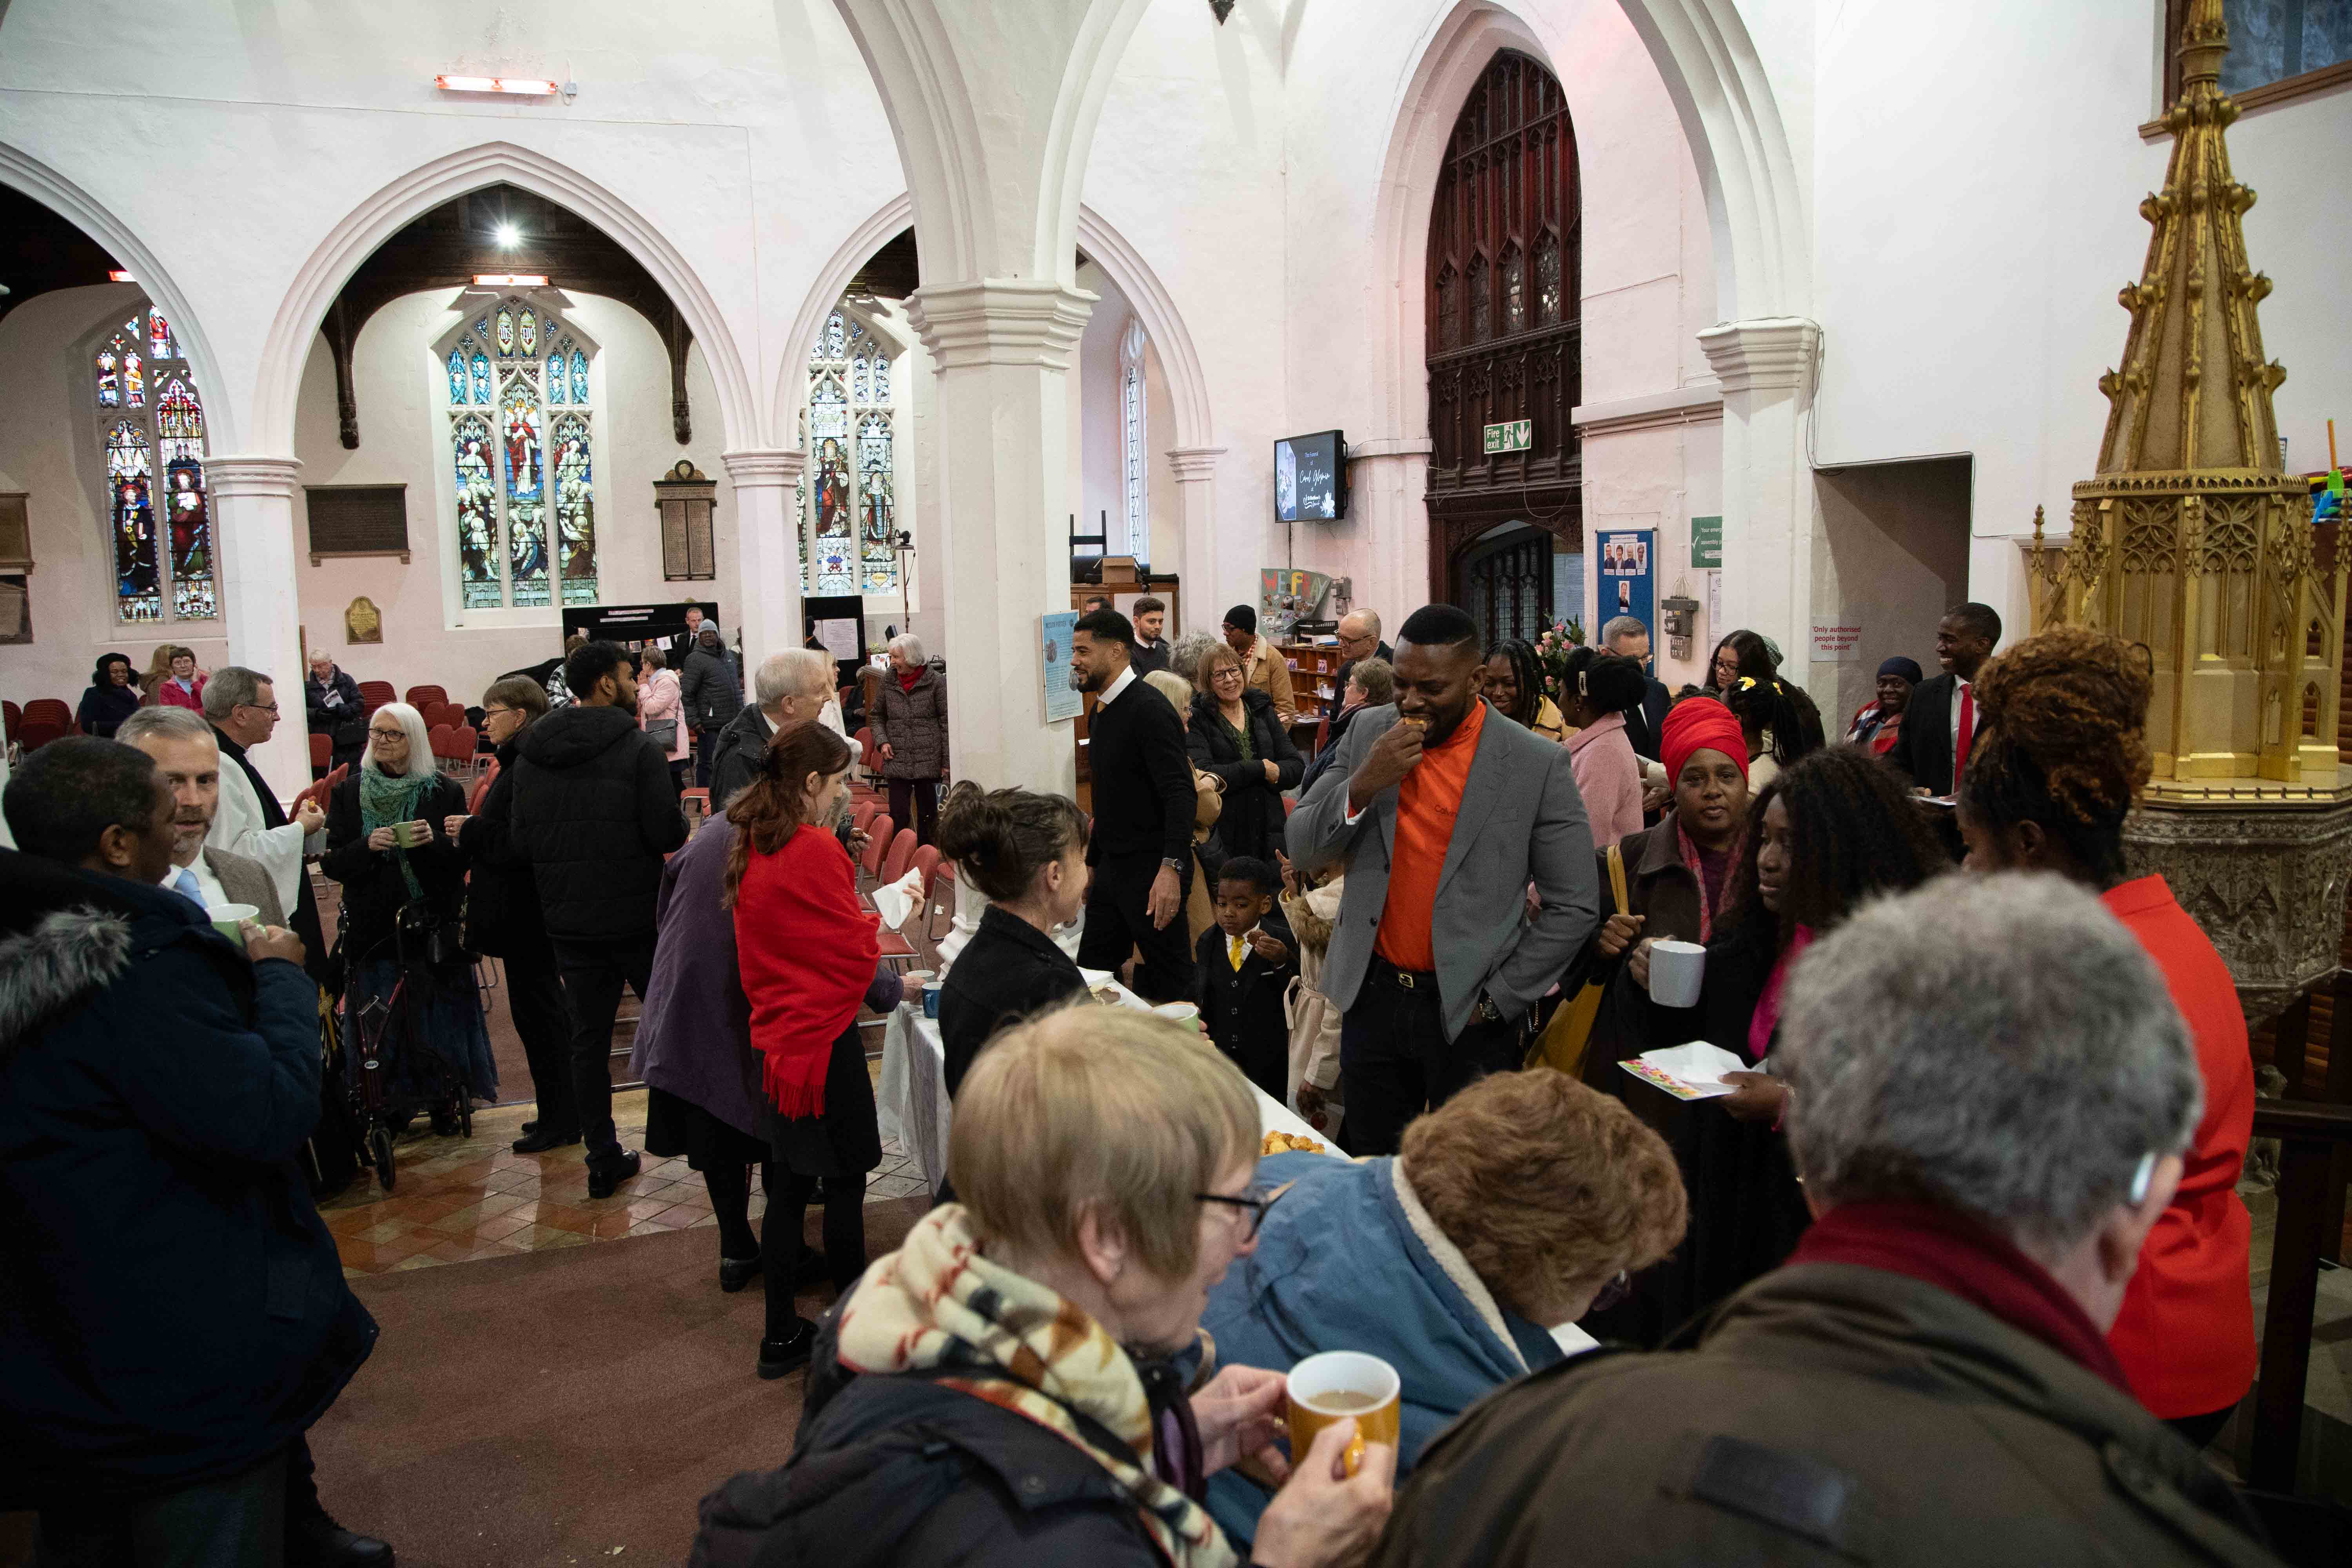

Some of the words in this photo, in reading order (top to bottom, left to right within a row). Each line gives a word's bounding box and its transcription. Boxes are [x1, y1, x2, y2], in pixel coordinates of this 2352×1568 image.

[1487, 428, 1499, 438] Fire
[1487, 439, 1499, 449] exit
[1300, 470, 1311, 483] Carol
[1262, 571, 1286, 594] WE
[1292, 572, 1327, 601] PRAY
